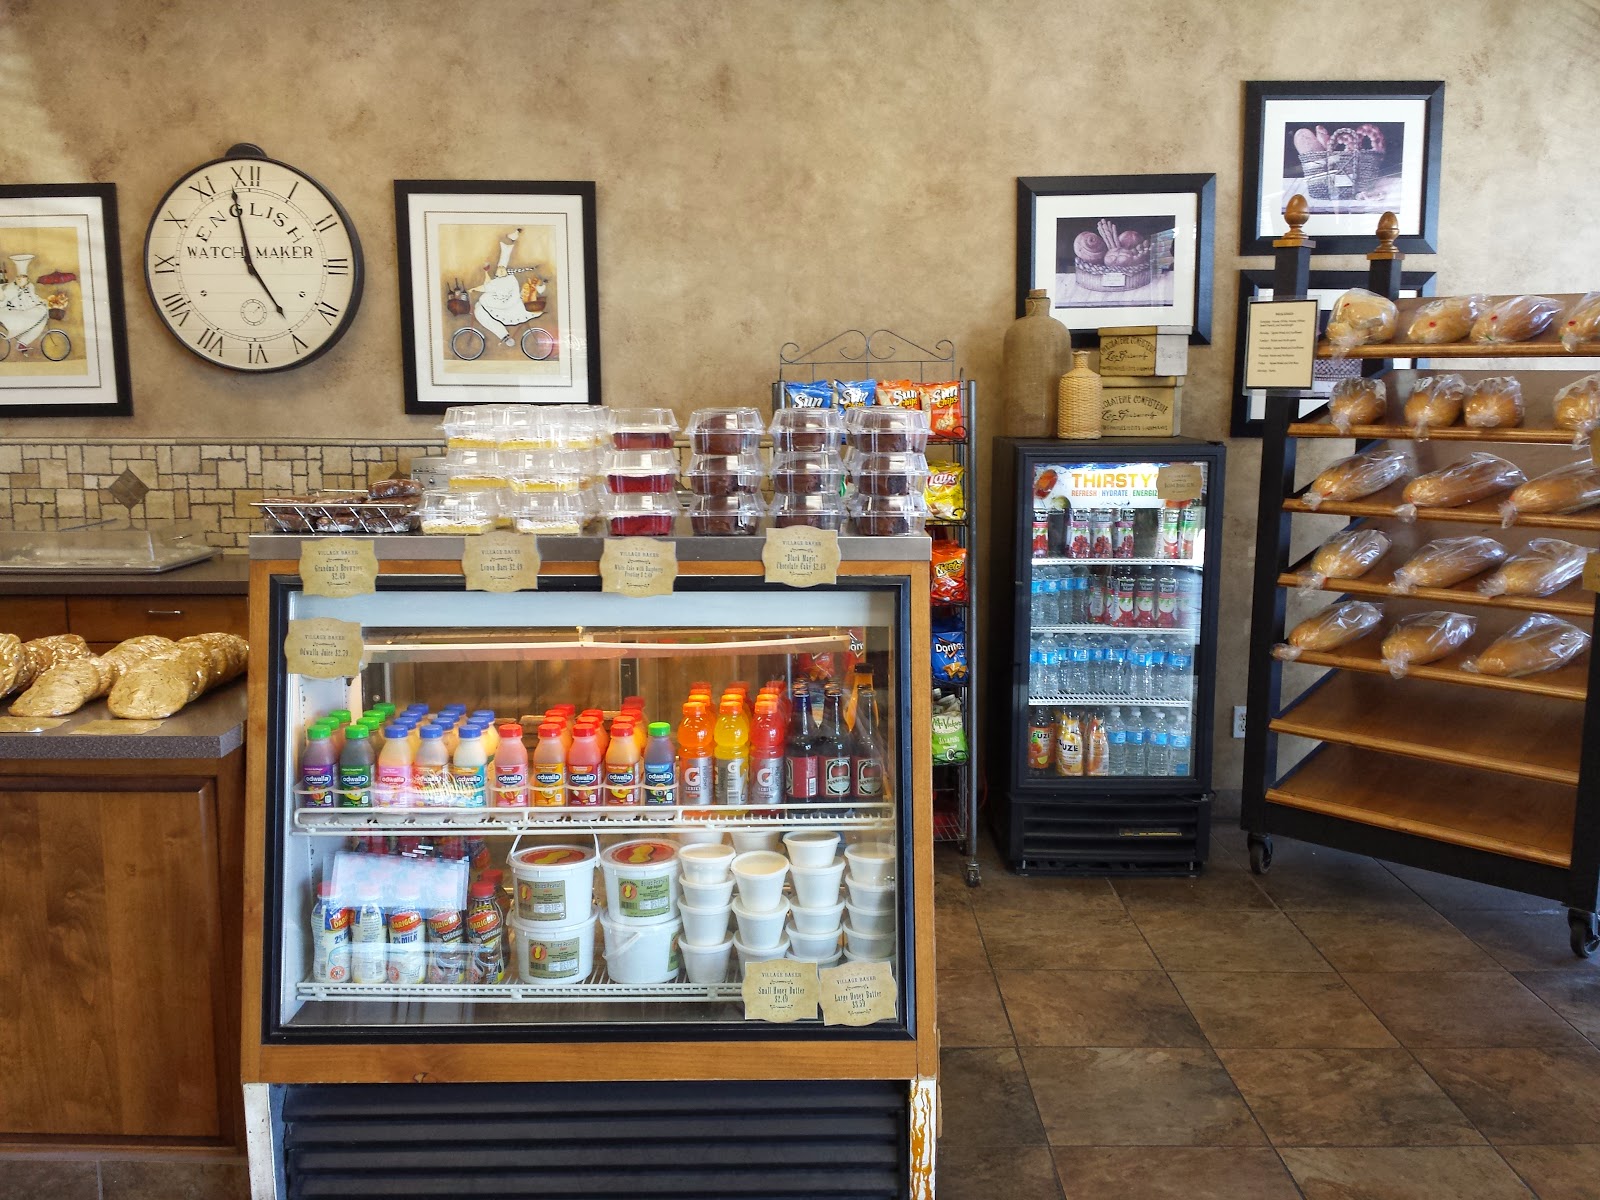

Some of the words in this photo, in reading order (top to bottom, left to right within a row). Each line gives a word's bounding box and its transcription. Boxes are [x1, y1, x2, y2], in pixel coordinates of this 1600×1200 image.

[231, 166, 260, 187] XII
[188, 176, 216, 201] XI
[163, 210, 186, 229] X
[196, 202, 305, 243] ENGLISH
[187, 246, 245, 259] WATCH
[255, 246, 314, 259] MAKER
[154, 254, 175, 274] IX
[328, 258, 348, 275] III
[792, 393, 823, 408] Sun
[893, 390, 917, 406] Sun
[931, 386, 957, 403] Sun
[402, 934, 418, 944] MILK
[758, 986, 772, 995] Small
